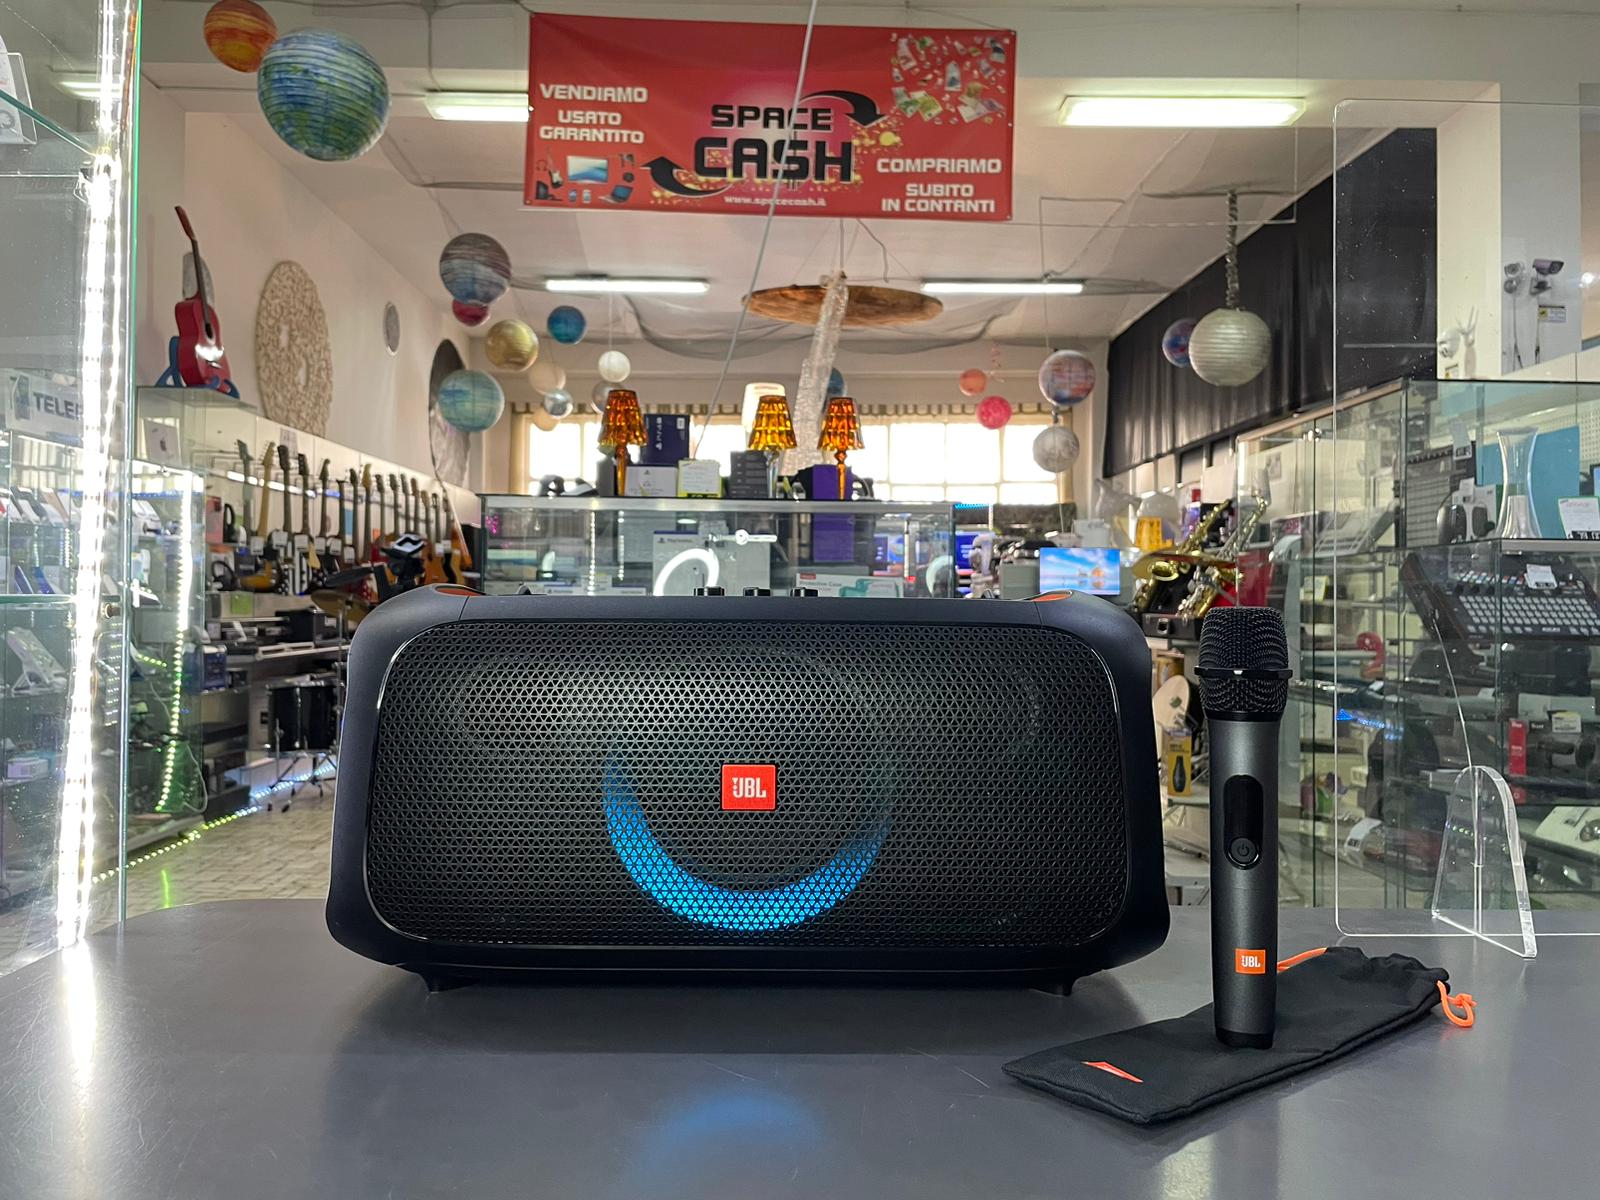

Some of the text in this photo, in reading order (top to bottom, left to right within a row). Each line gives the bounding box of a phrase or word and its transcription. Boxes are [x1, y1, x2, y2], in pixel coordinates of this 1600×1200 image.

[540, 84, 648, 103] VENDIAMO
[558, 110, 622, 125] USATO
[711, 104, 832, 131] SPACE
[540, 126, 645, 144] GARANTITO
[694, 137, 853, 183] CASH
[877, 158, 1002, 173] COMPRIAMO
[905, 183, 974, 197] SUBITO
[881, 198, 996, 213] IN CONTANTI
[732, 777, 767, 798] JBL
[1241, 955, 1261, 968] JBL
